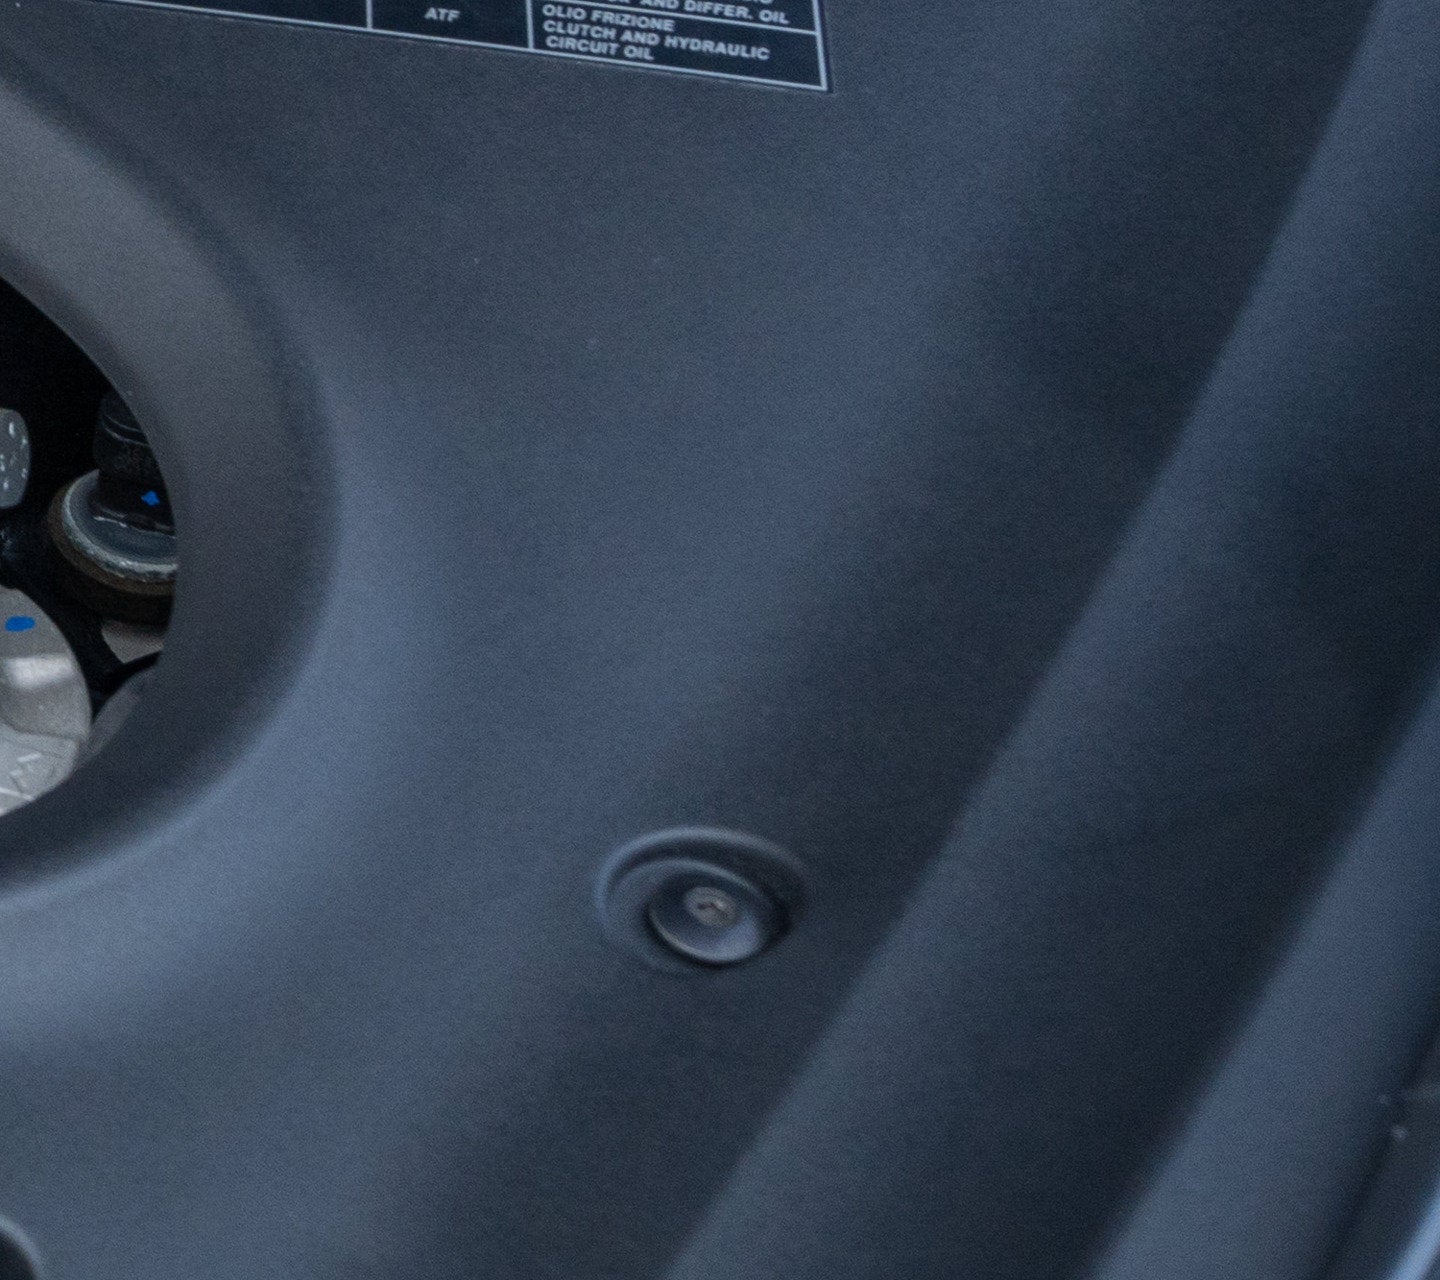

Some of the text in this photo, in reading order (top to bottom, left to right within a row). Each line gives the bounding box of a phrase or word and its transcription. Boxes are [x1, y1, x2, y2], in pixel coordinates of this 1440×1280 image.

[424, 6, 460, 23] ATF
[542, 4, 675, 32] OLIO FRIZIONE
[683, 0, 754, 20] DIFFER.
[758, 8, 790, 24] OIL
[542, 19, 770, 61] CLUTCH AND HYDRAULIC
[545, 34, 654, 61] CIRCUIT OIL
